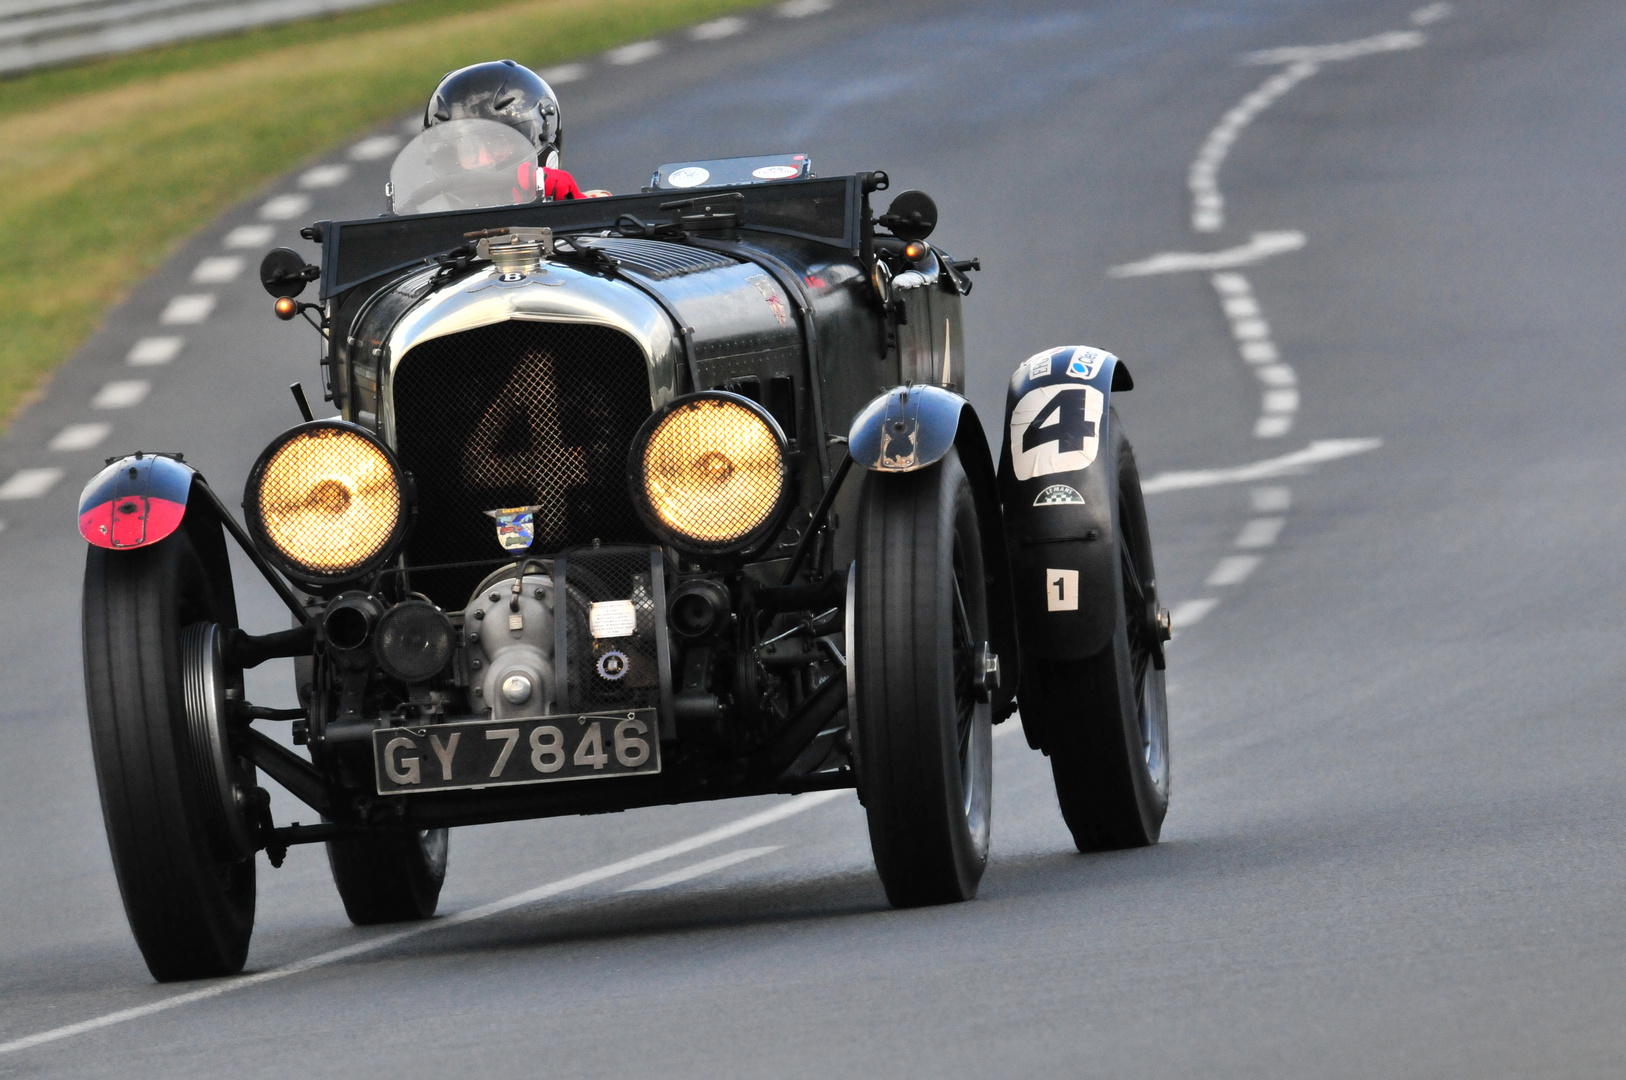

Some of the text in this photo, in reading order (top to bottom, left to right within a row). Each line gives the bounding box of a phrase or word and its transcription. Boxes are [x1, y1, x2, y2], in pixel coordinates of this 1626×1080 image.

[503, 272, 522, 281] B
[462, 349, 588, 544] 4
[1022, 389, 1096, 454] 4
[1053, 577, 1065, 601] 1
[384, 719, 650, 785] GY 7846
